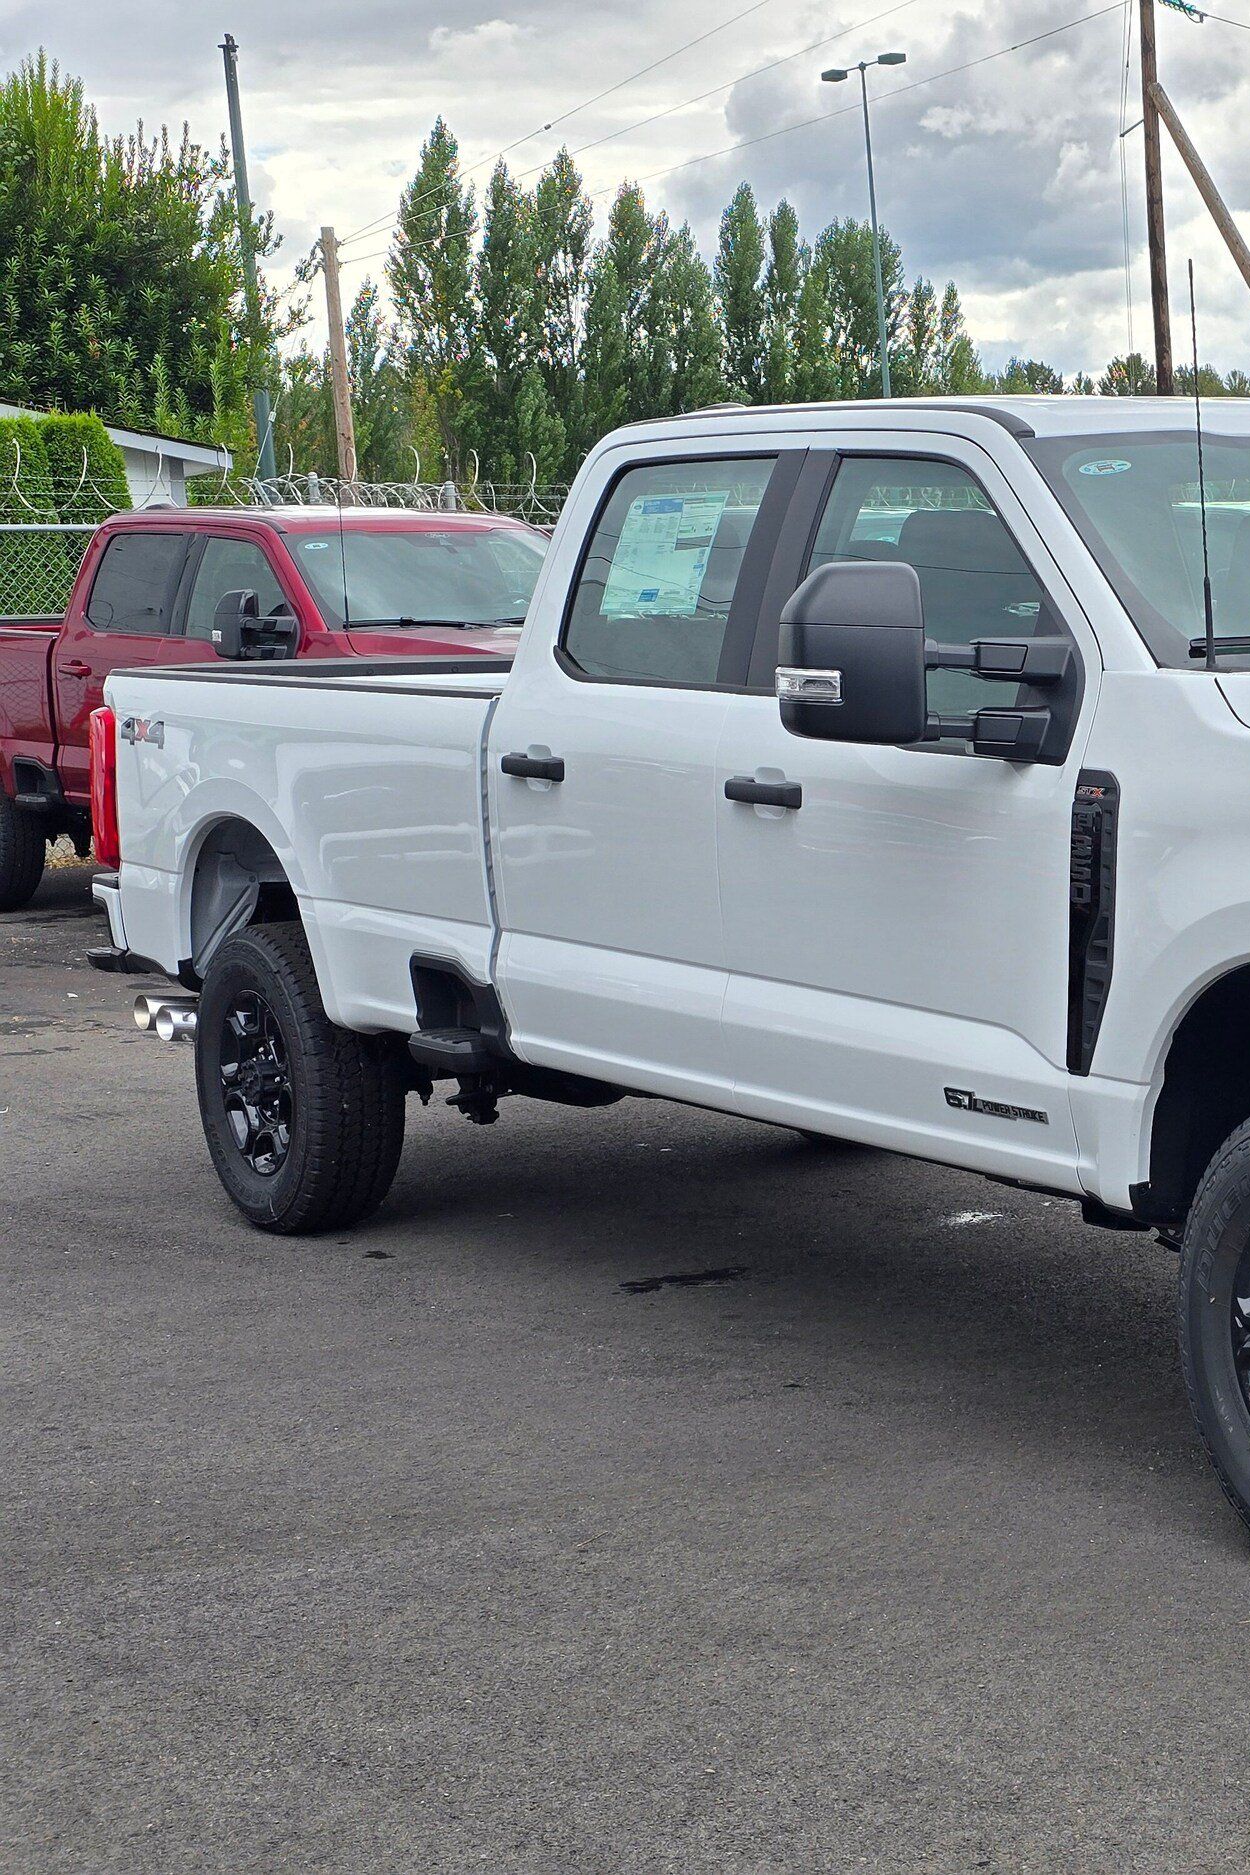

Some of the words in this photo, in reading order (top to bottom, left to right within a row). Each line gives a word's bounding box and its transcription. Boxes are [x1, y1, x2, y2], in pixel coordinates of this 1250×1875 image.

[1077, 786, 1105, 799] STX
[982, 1100, 1012, 1115] POWER
[1012, 1106, 1049, 1125] STROKE
